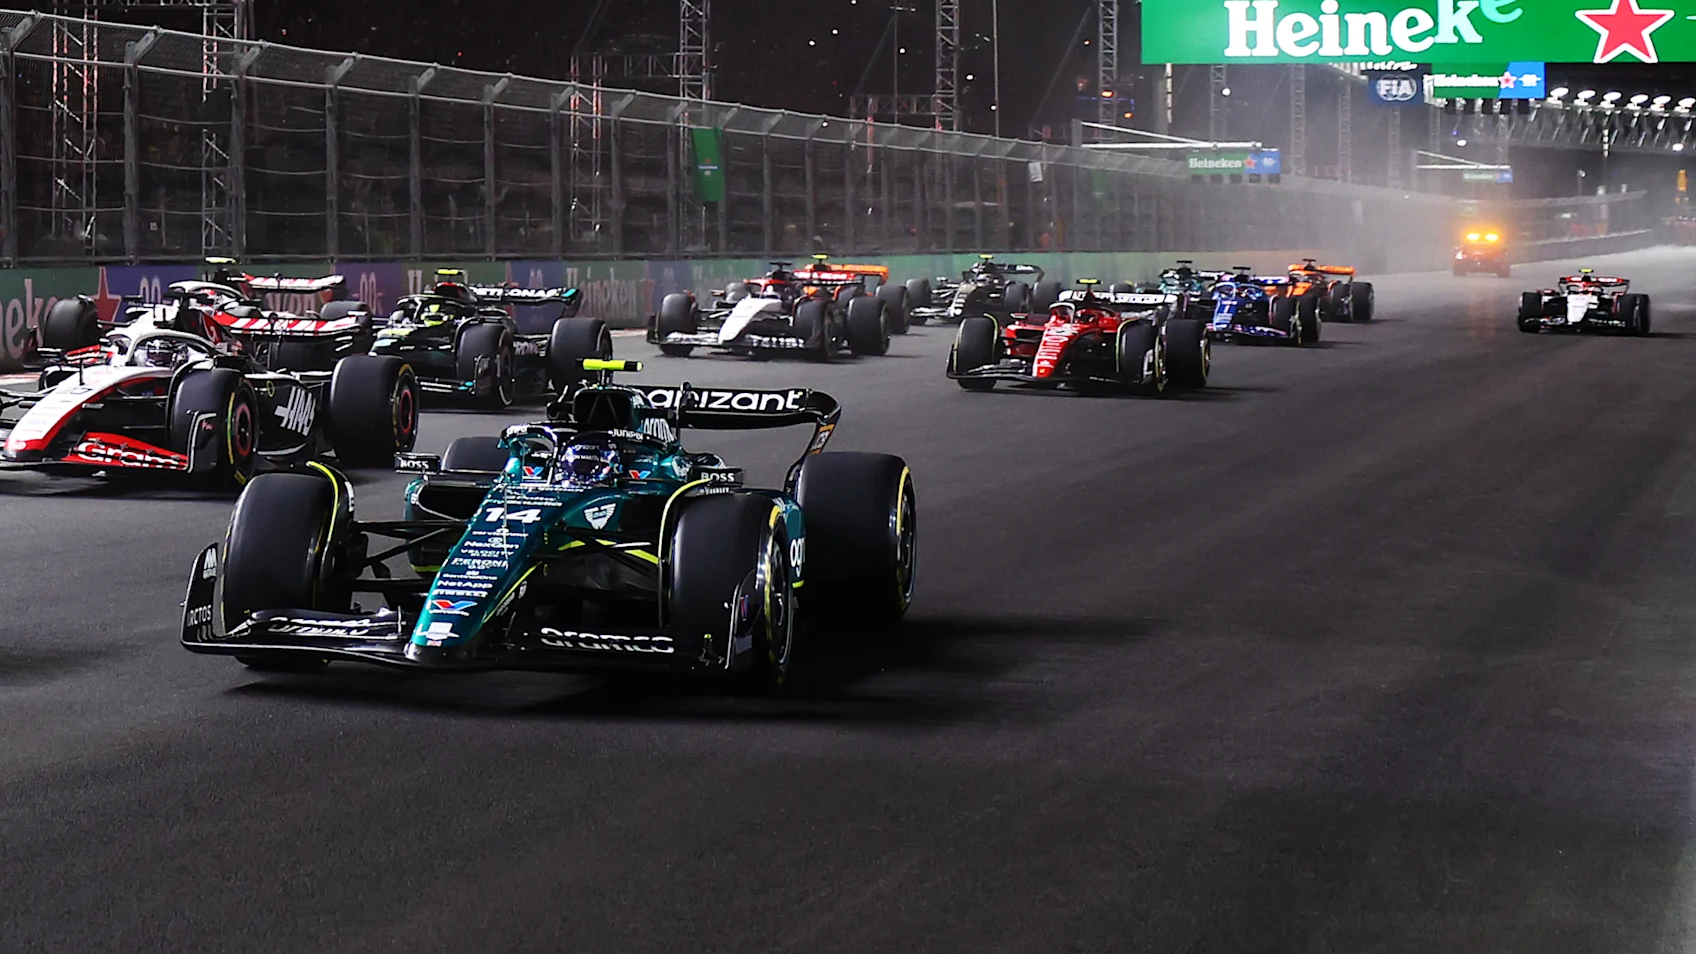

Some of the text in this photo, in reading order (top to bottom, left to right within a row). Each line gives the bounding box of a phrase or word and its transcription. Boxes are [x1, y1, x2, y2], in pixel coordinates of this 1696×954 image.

[400, 459, 430, 470] BOSS
[700, 472, 735, 483] BOSS
[485, 507, 542, 524] 14
[436, 580, 494, 589] NetApp
